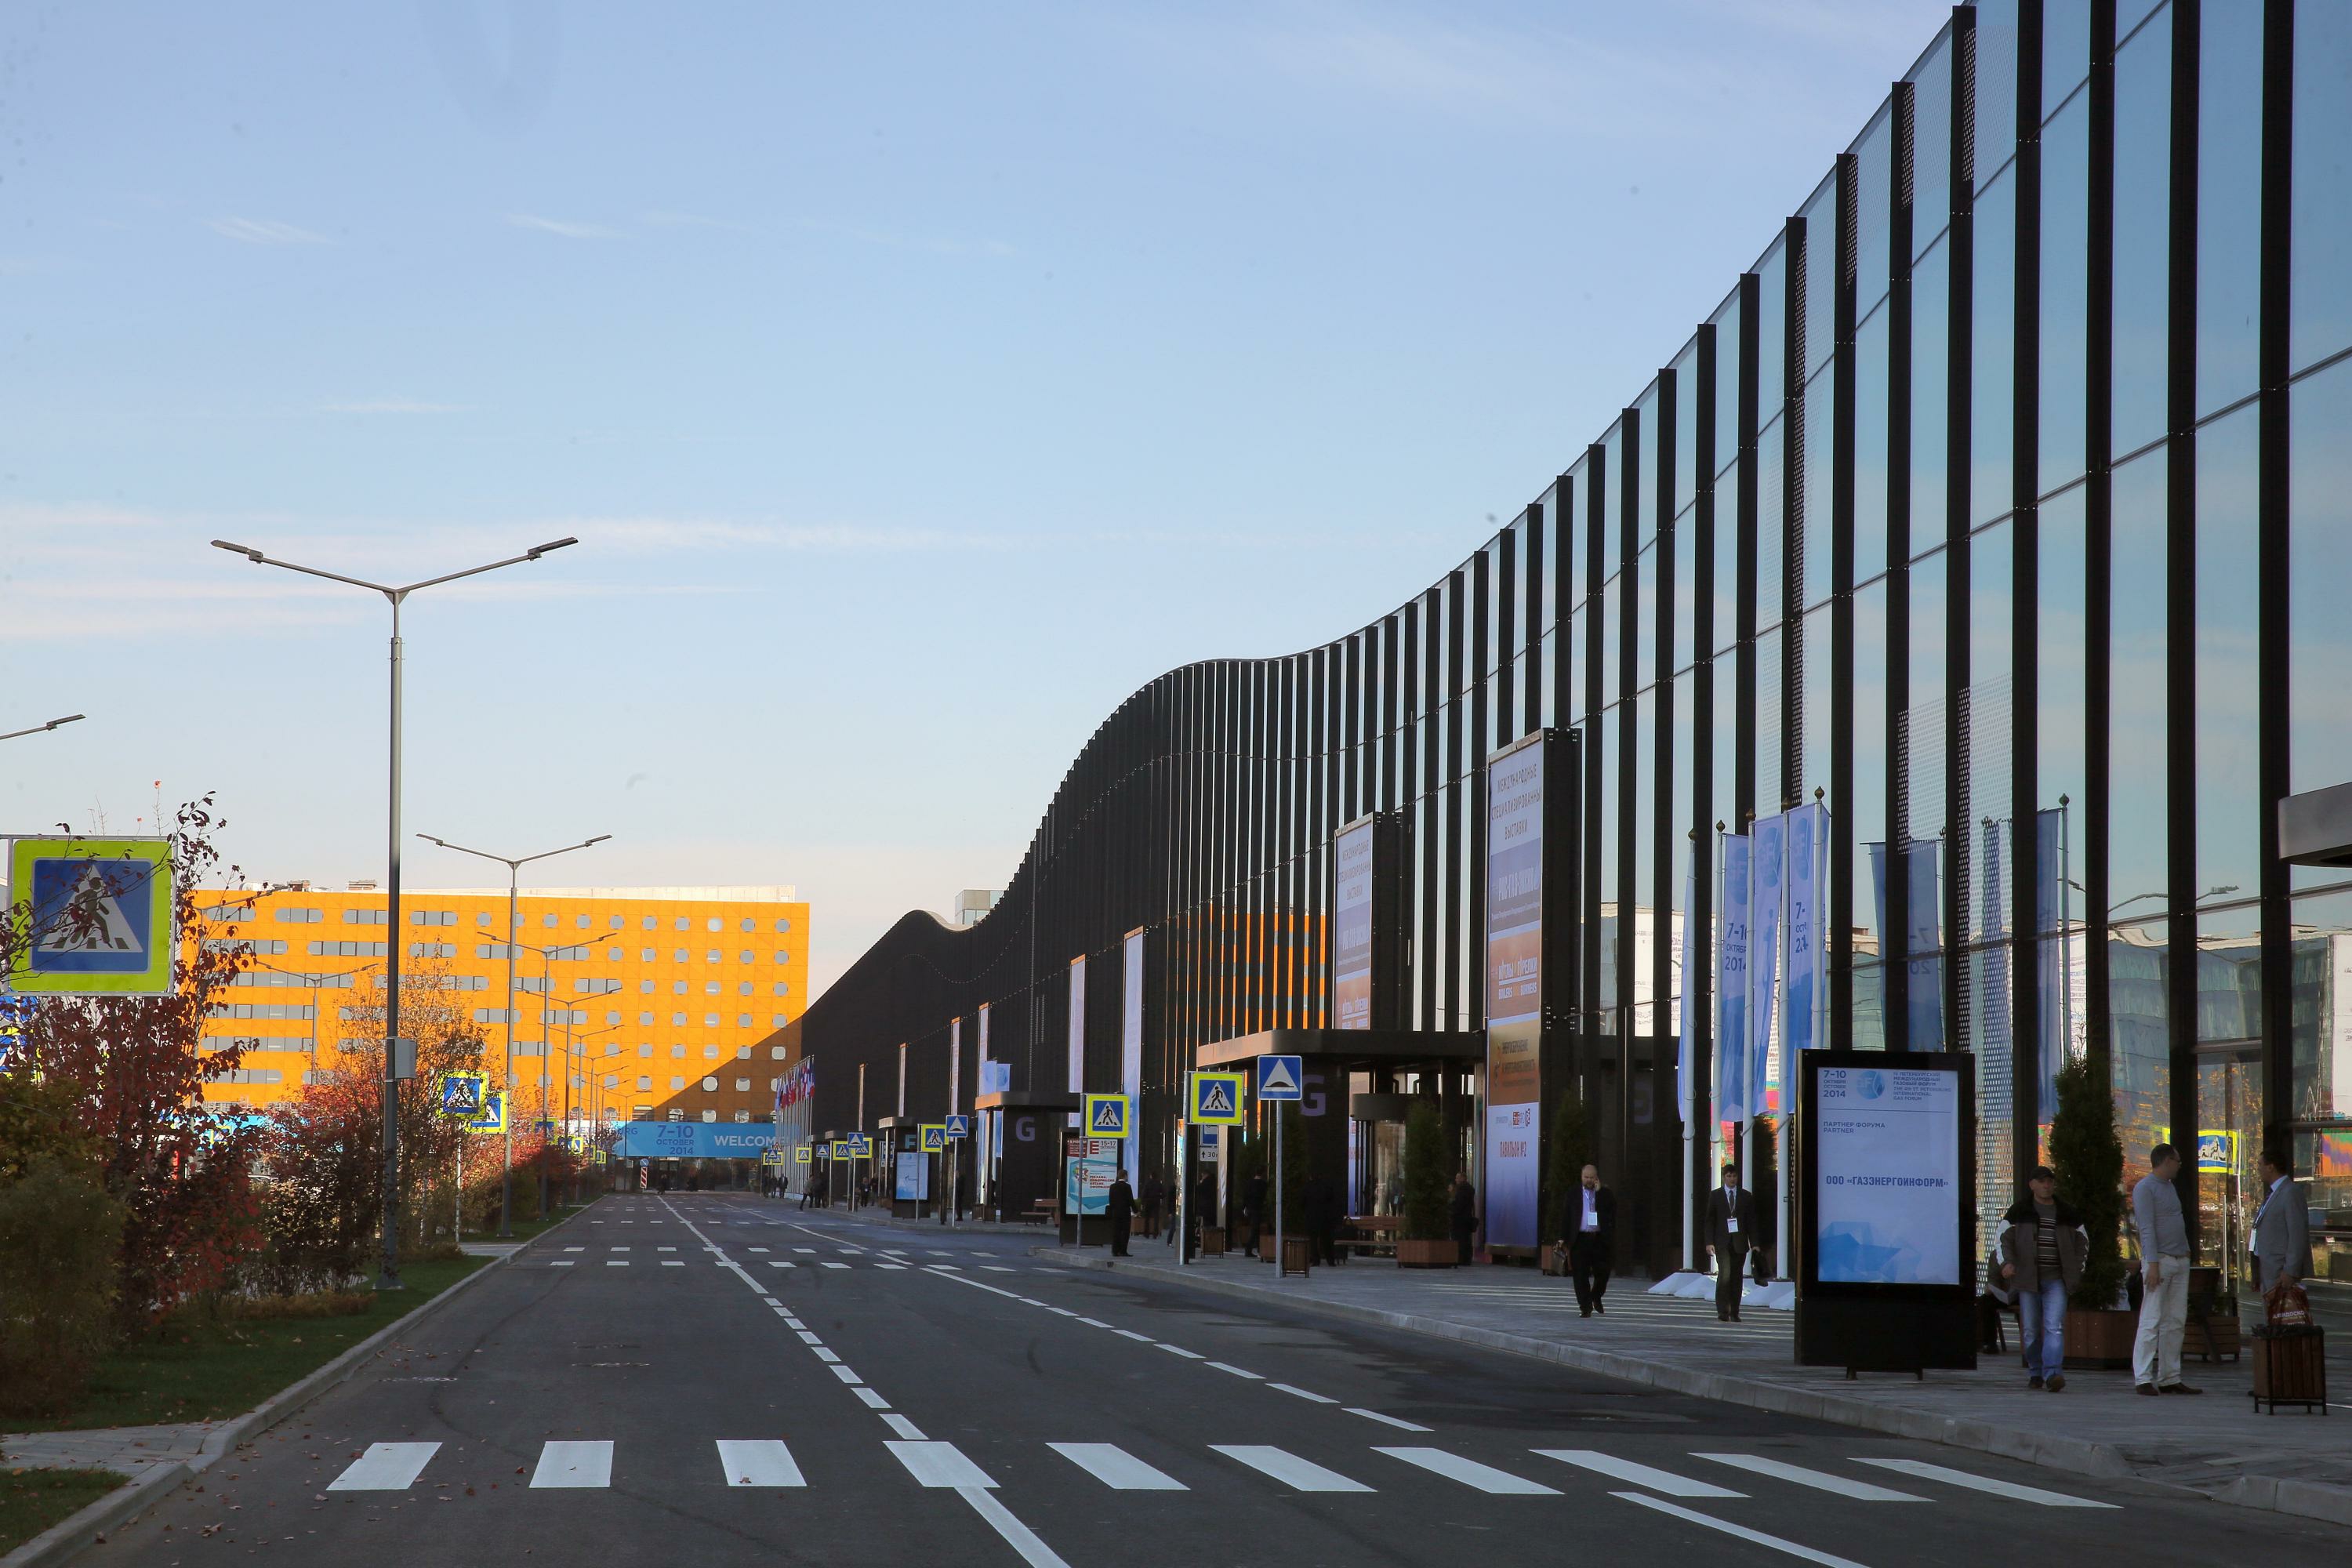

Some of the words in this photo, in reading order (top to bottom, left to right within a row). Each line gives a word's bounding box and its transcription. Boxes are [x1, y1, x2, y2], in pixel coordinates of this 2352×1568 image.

[1491, 788, 1541, 821] СПЕЦИАЛИЗИРОВАННЫ
[1504, 818, 1528, 840] ВЫСТАВКИ
[1726, 943, 1747, 953] ОКТЯБР
[1300, 1074, 1327, 1117] G
[1015, 1116, 1036, 1142] G
[714, 1135, 778, 1146] WELCOM
[1846, 1176, 1949, 1188] «ГАЗЭНЕРГОИНФОРМ»
